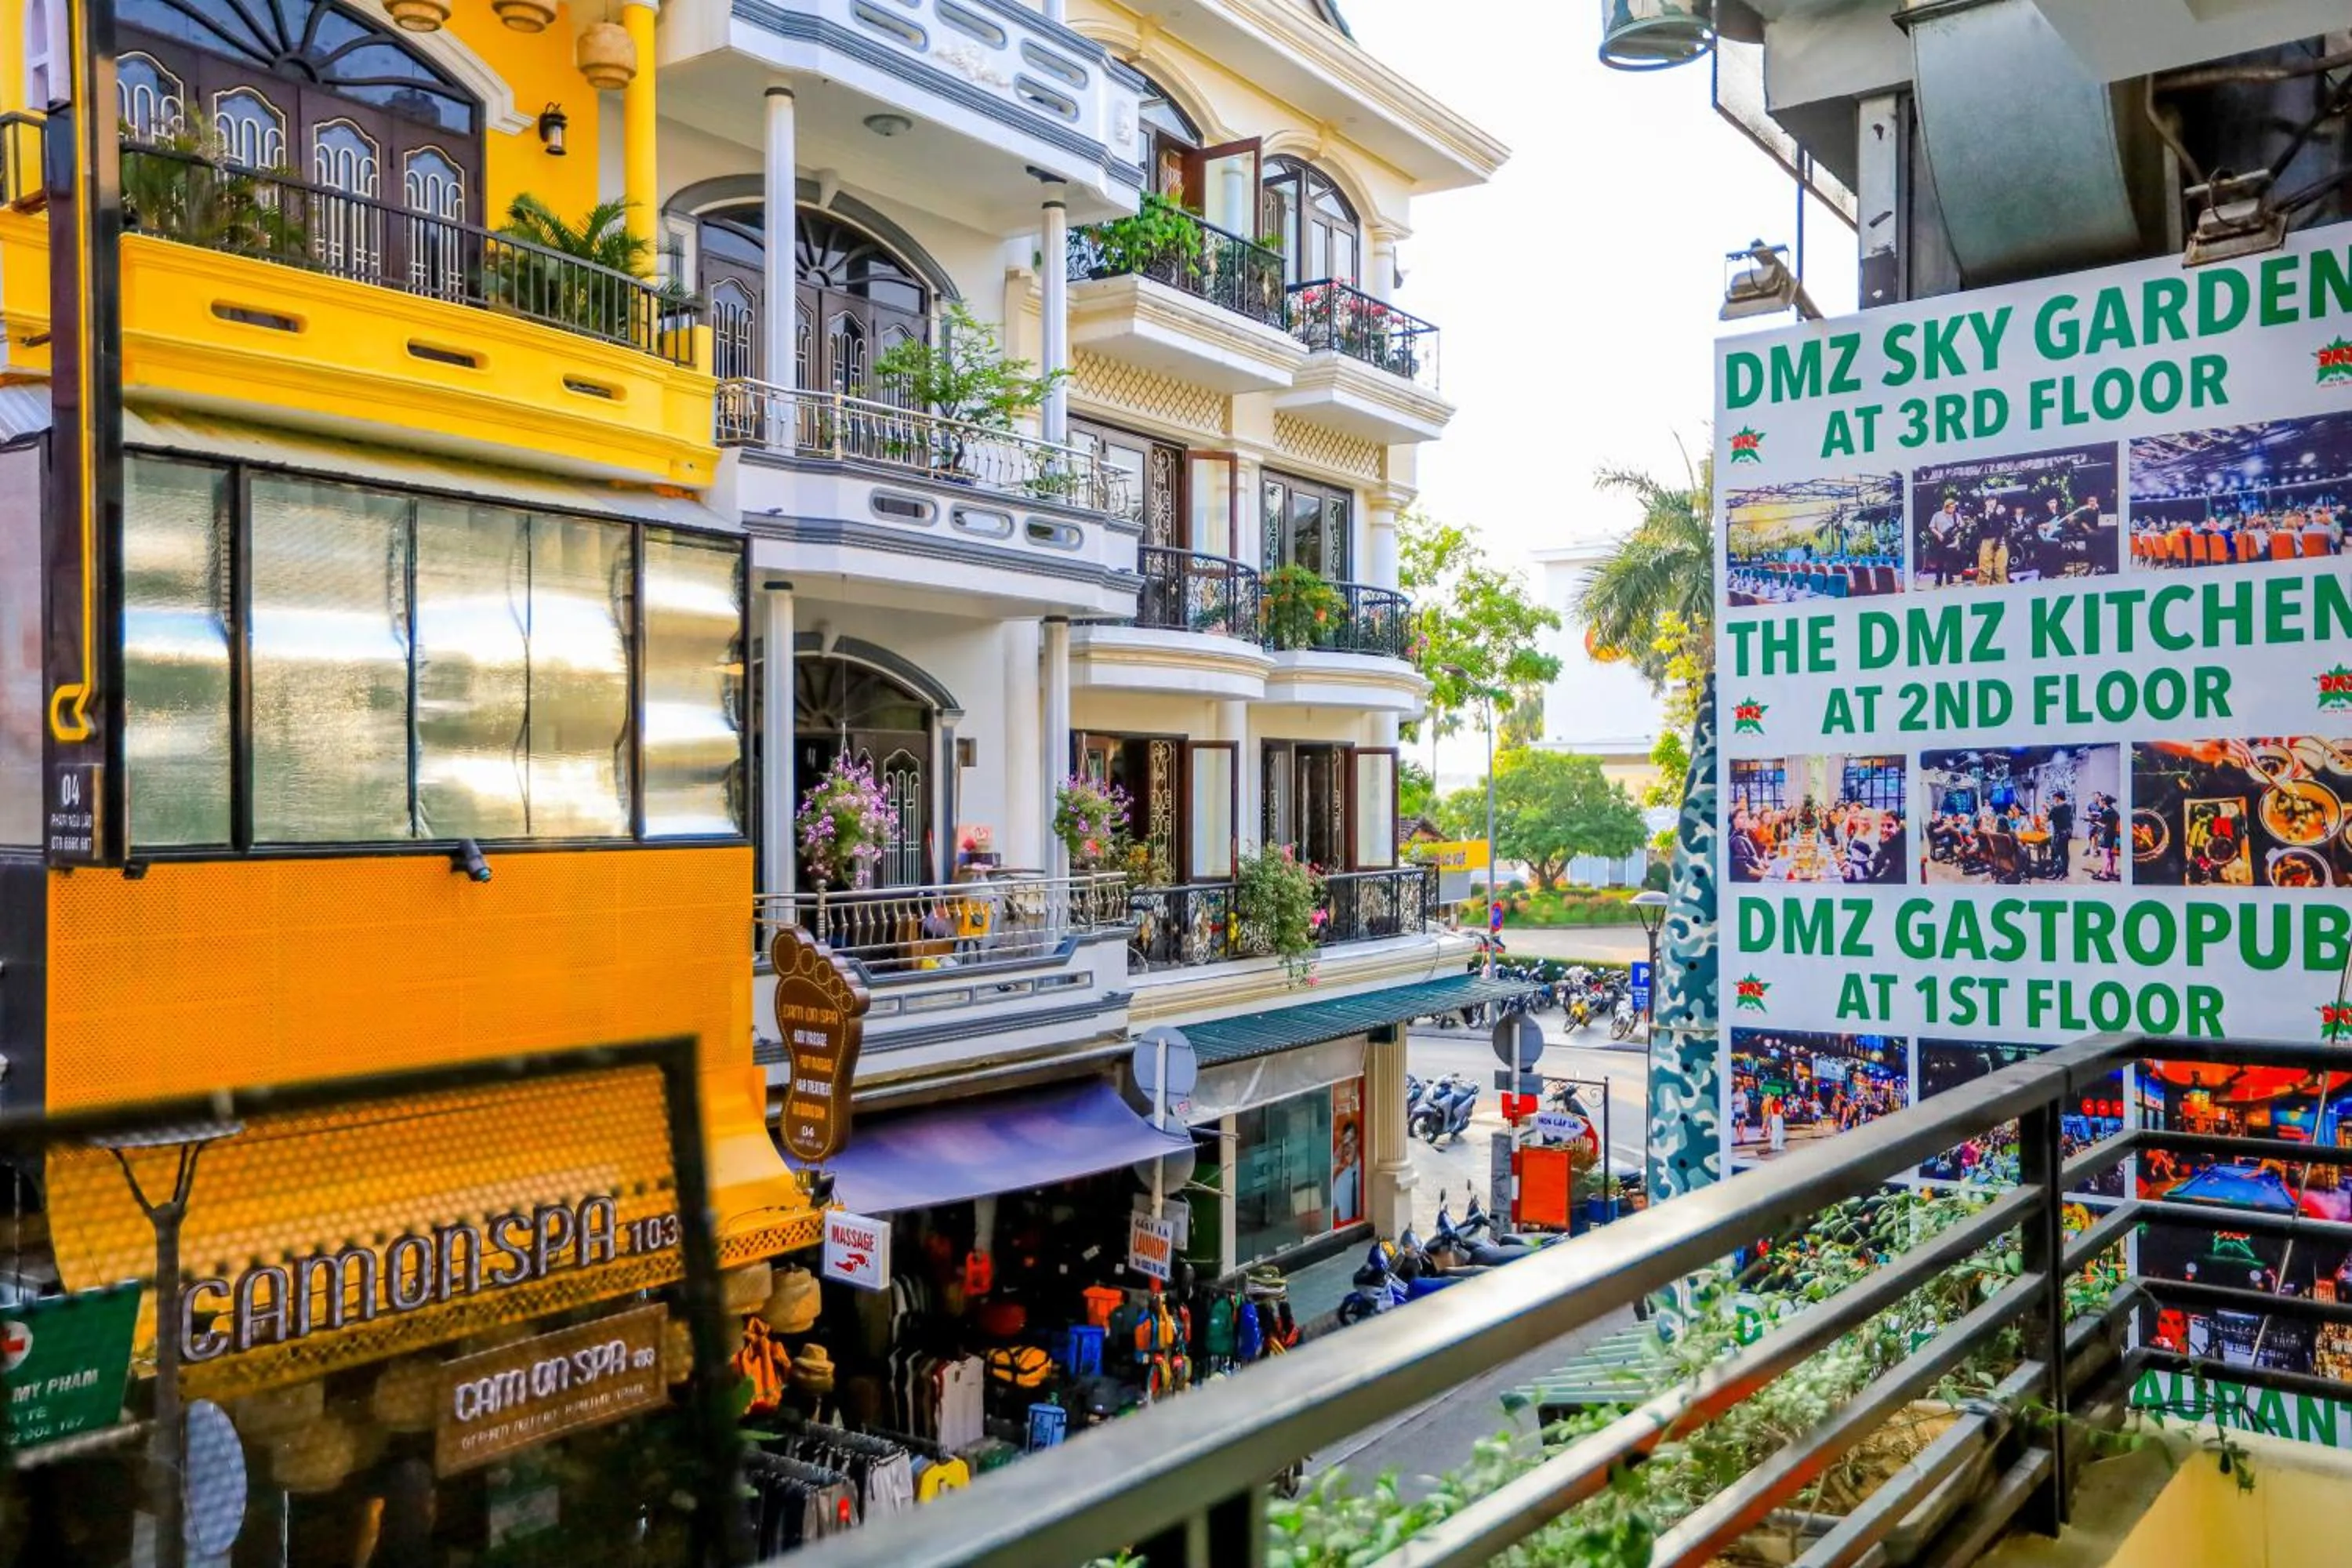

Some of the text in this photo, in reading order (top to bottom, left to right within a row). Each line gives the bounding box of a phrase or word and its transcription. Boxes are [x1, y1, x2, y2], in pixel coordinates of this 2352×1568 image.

[1726, 245, 2352, 409] DMZ SKY GARDEN
[1821, 354, 2228, 458] AT 3RD FLOOR
[1726, 574, 2352, 677] THE DMZ KITCHEN
[1821, 666, 2232, 735] AT 2ND FLOOR
[60, 774, 80, 806] 04
[1738, 896, 2351, 972] DMZ GASTROPUB
[1836, 973, 2225, 1041] AT 1ST FLOOR
[488, 1193, 616, 1287] SPA
[630, 1213, 681, 1254] 103
[831, 1224, 874, 1253] MASSAGE
[455, 1369, 526, 1422] CAM
[532, 1356, 569, 1398] ON
[573, 1339, 626, 1385] SPA
